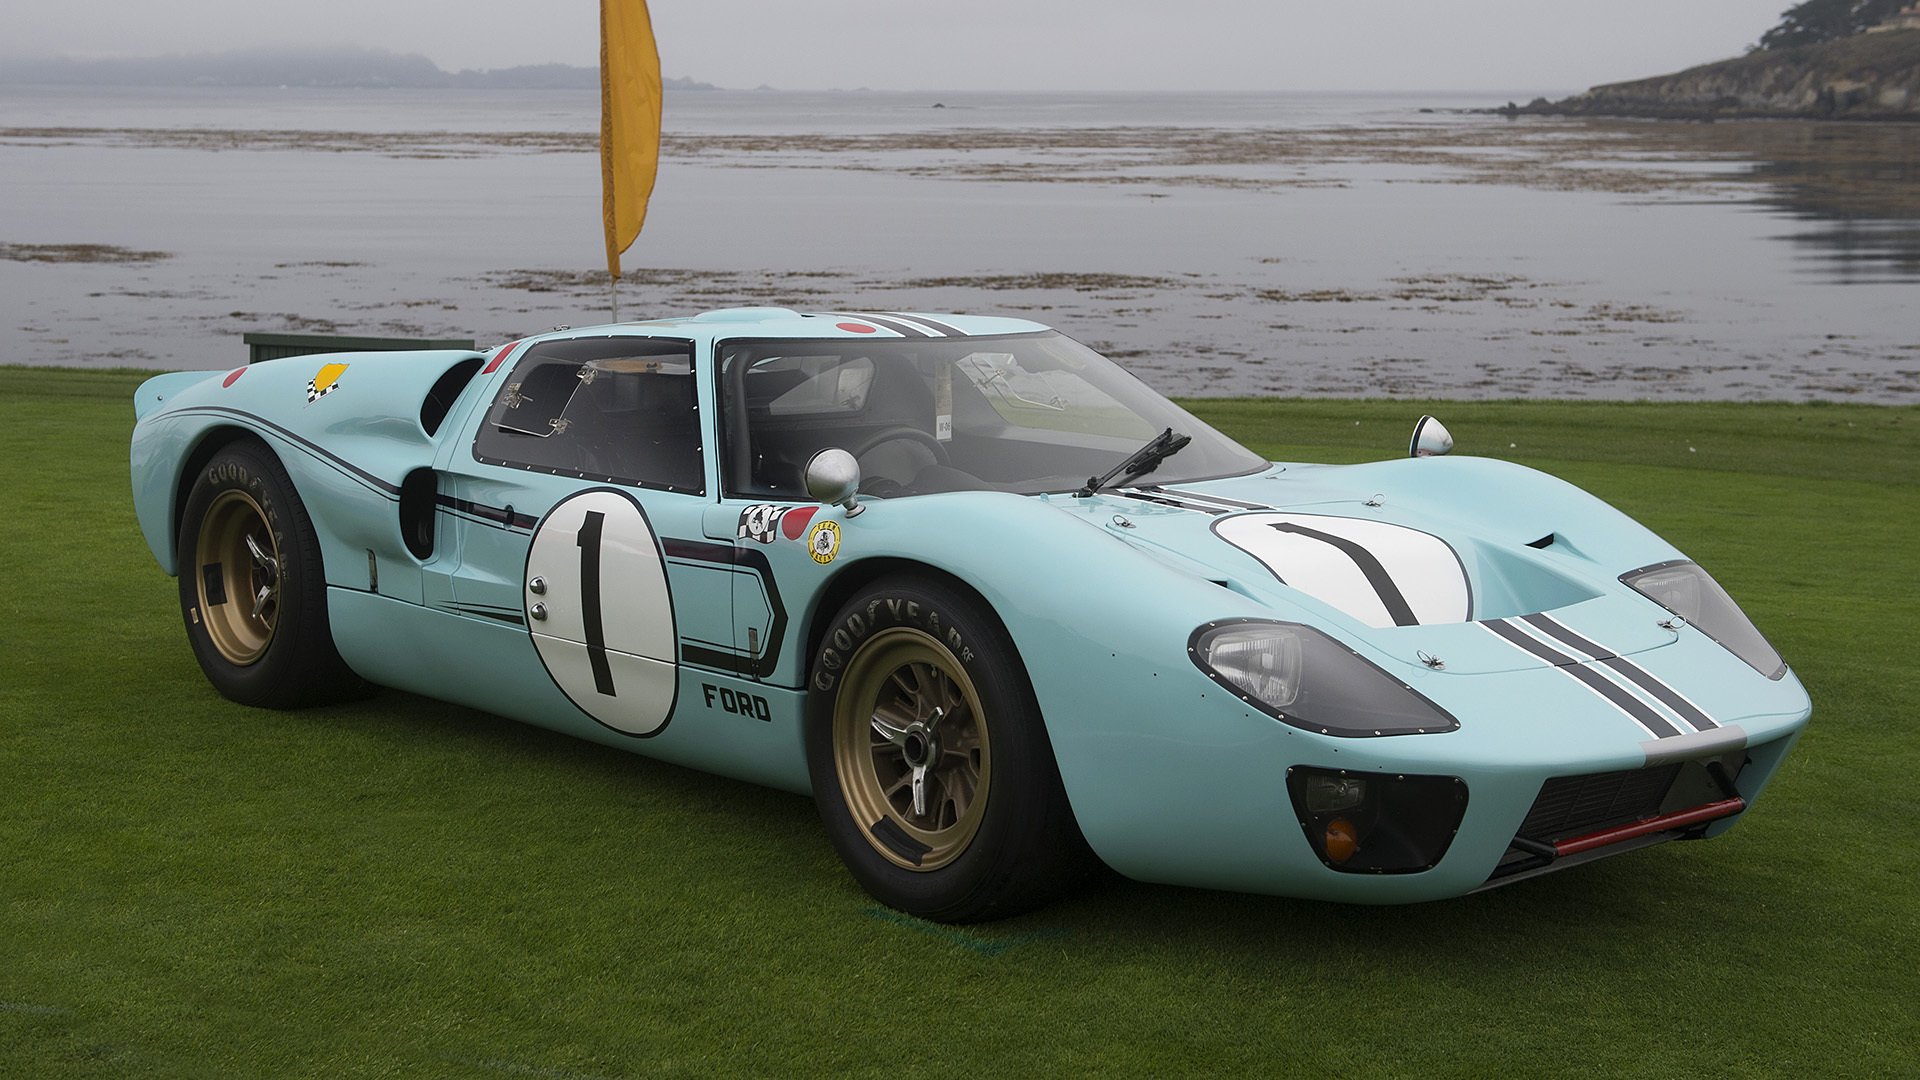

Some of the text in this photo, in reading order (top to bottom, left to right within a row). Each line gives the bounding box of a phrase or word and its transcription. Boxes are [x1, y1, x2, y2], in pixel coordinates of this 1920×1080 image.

[577, 510, 616, 697] 1
[1266, 523, 1420, 627] 1
[702, 683, 771, 722] FORD
